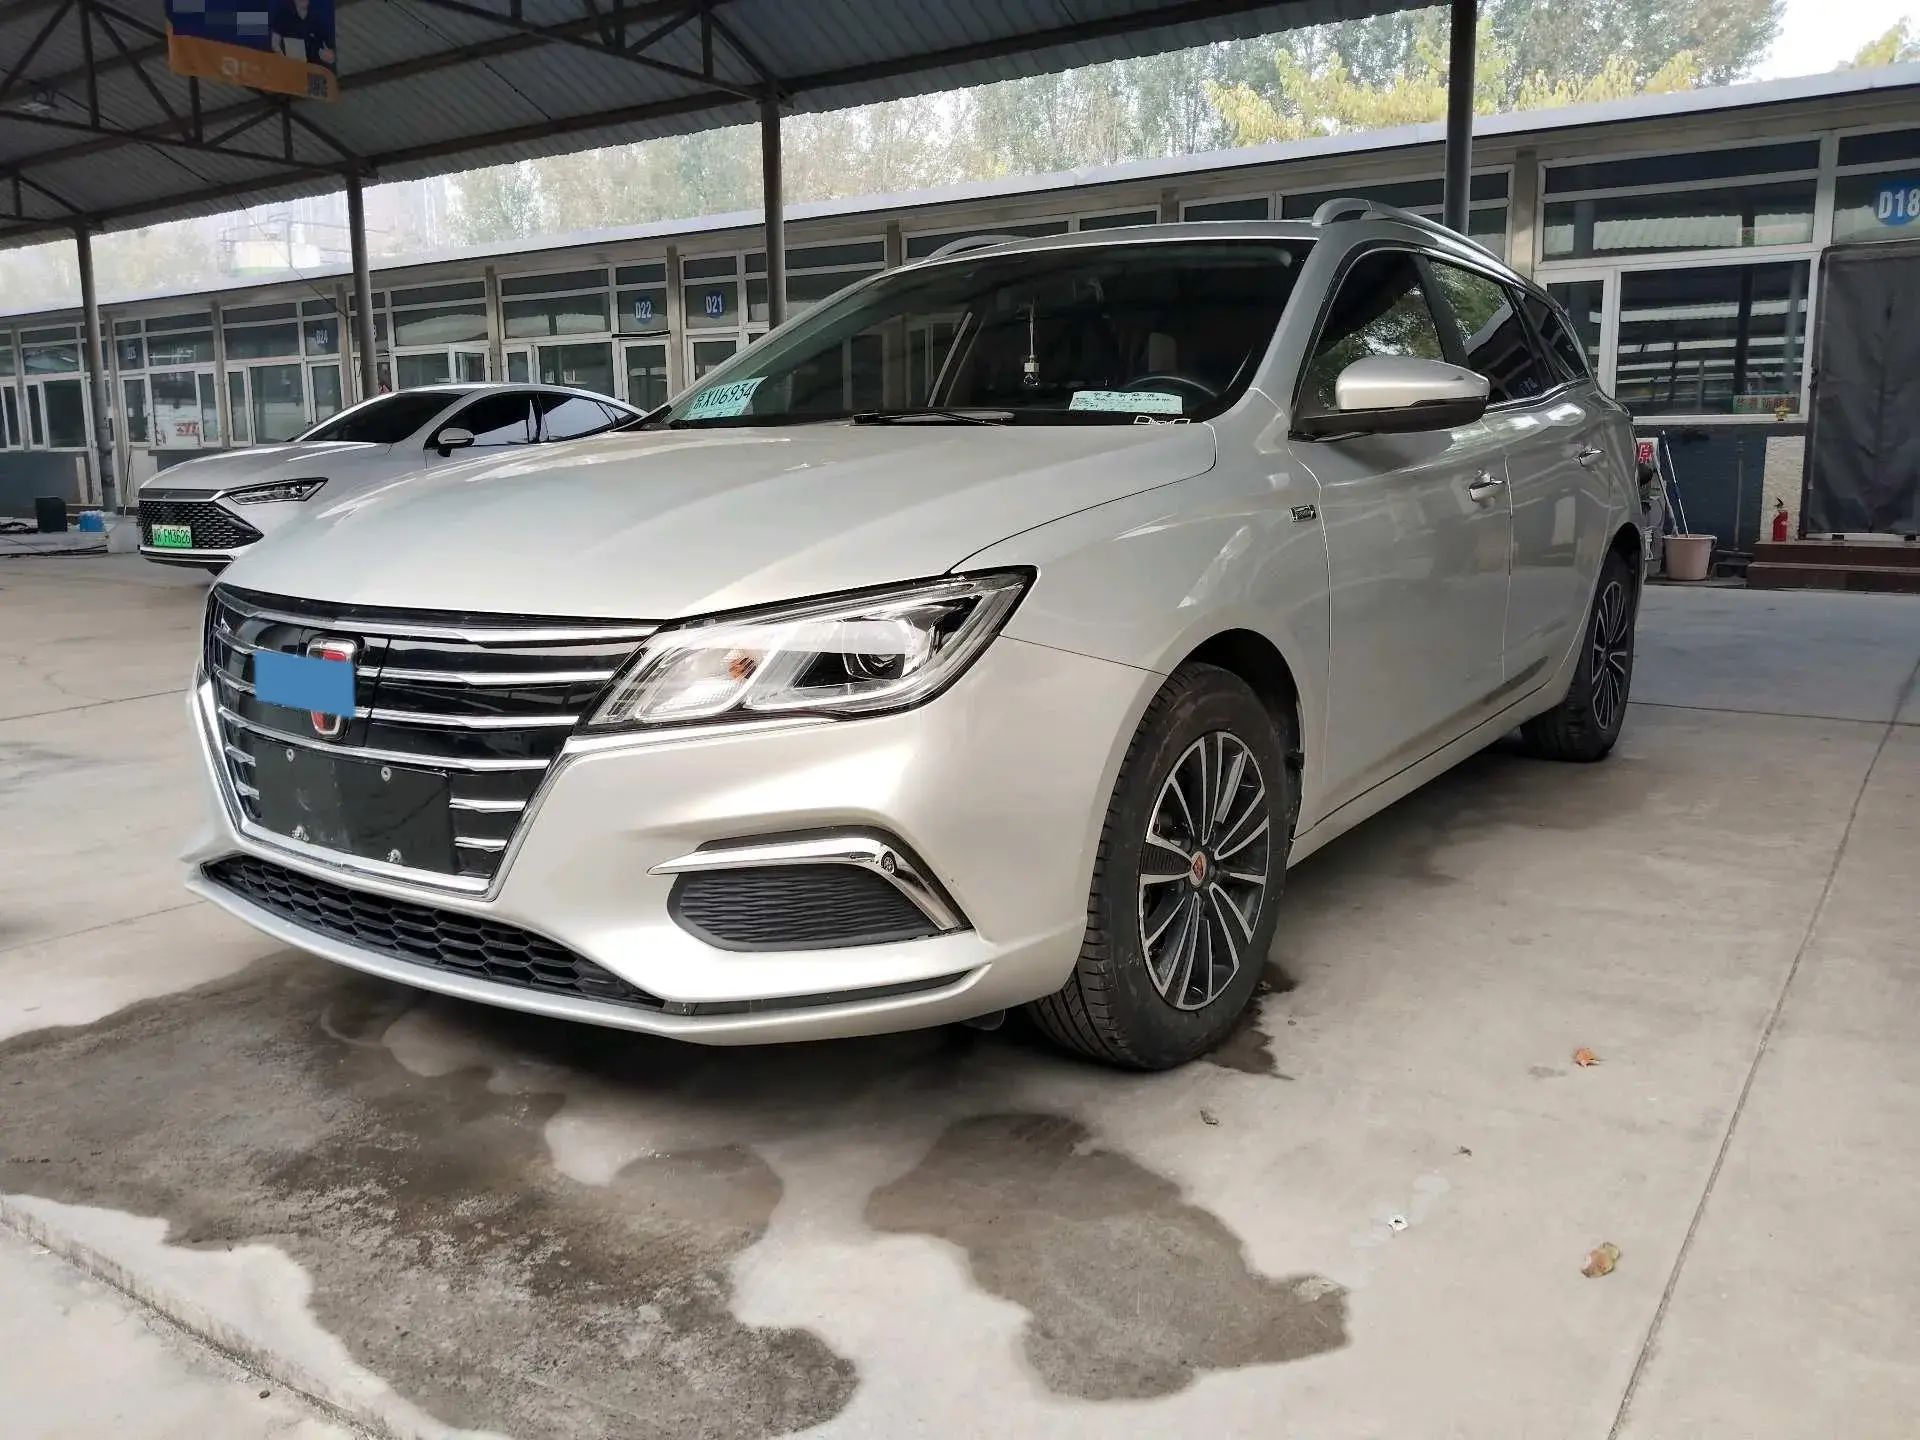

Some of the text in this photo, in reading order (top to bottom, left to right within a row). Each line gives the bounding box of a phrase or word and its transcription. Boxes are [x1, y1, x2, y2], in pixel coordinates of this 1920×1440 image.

[1878, 188, 1920, 219] D18
[635, 301, 652, 319] D22
[706, 294, 723, 314] D21
